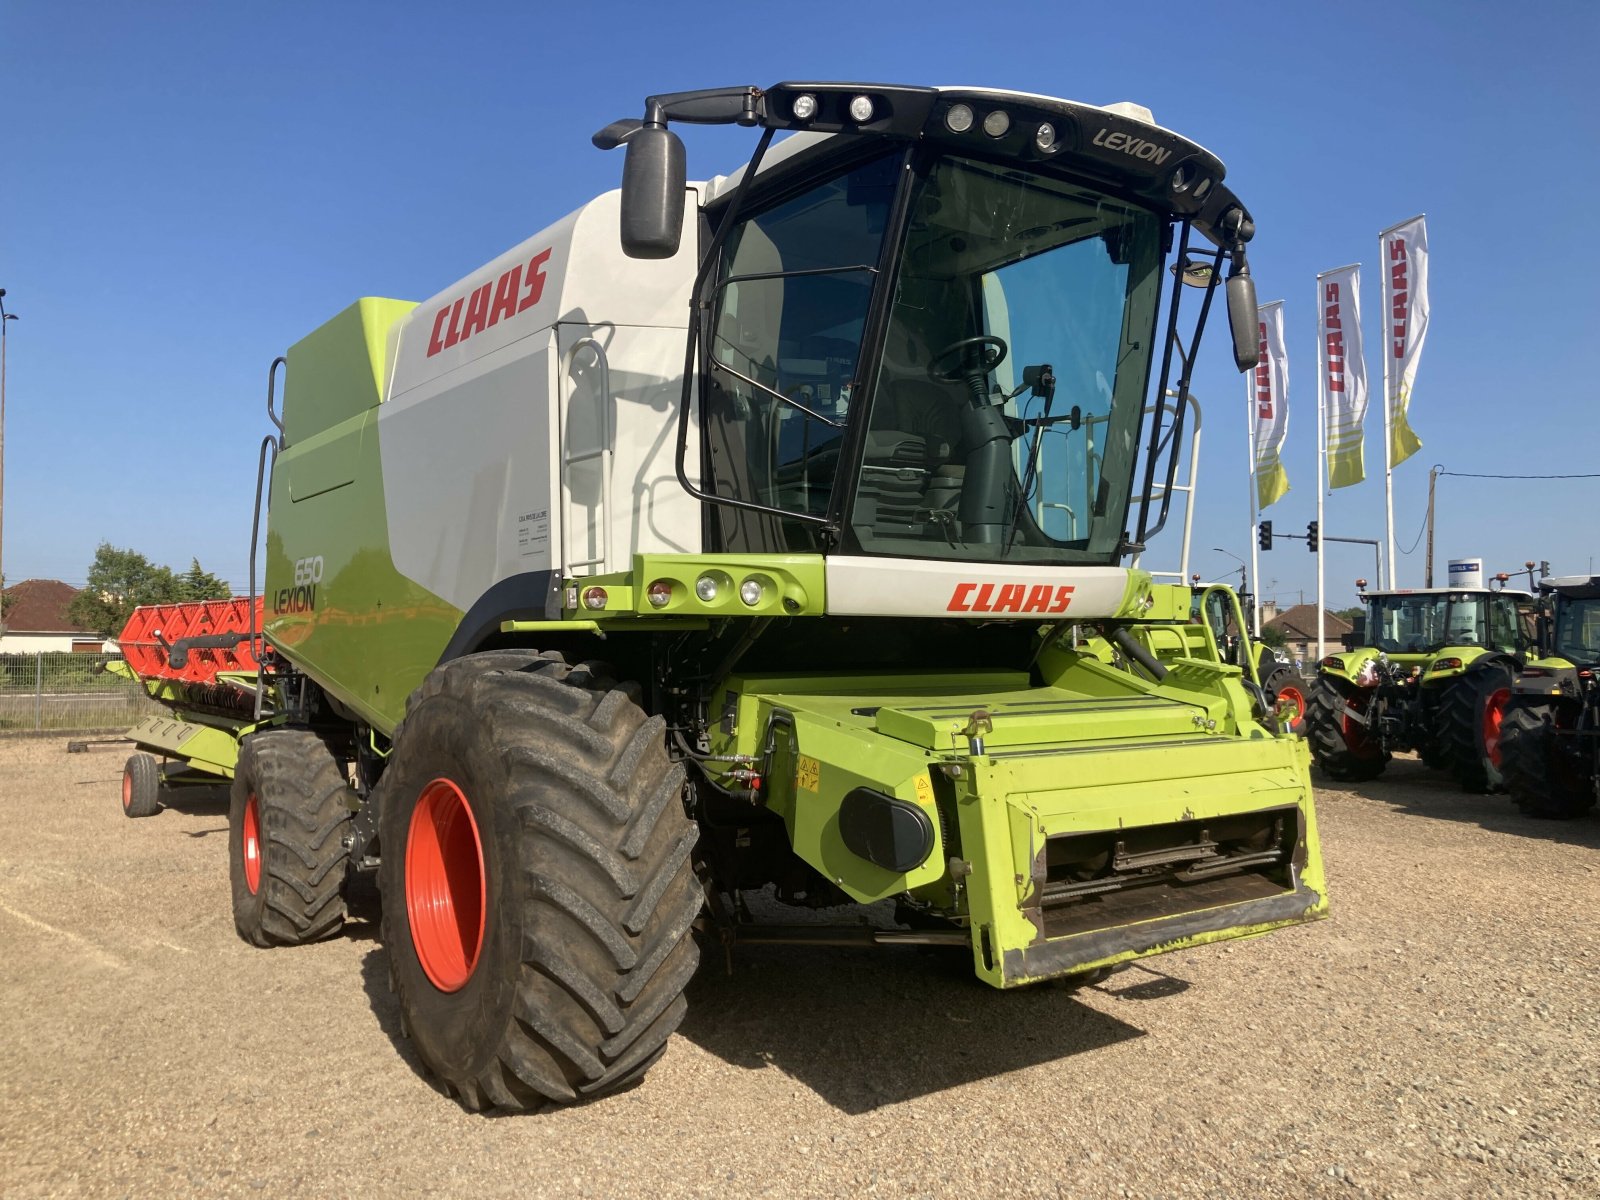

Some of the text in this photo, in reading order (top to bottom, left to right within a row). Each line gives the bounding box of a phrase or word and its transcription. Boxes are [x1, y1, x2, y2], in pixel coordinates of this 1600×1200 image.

[1092, 128, 1172, 165] LEXION
[426, 246, 553, 359] CLAAS
[1389, 238, 1407, 359] CLAAS
[1326, 282, 1345, 393] CLAAS
[294, 554, 324, 587] 650
[273, 583, 316, 615] LEXION
[946, 583, 1076, 614] CLAAS
